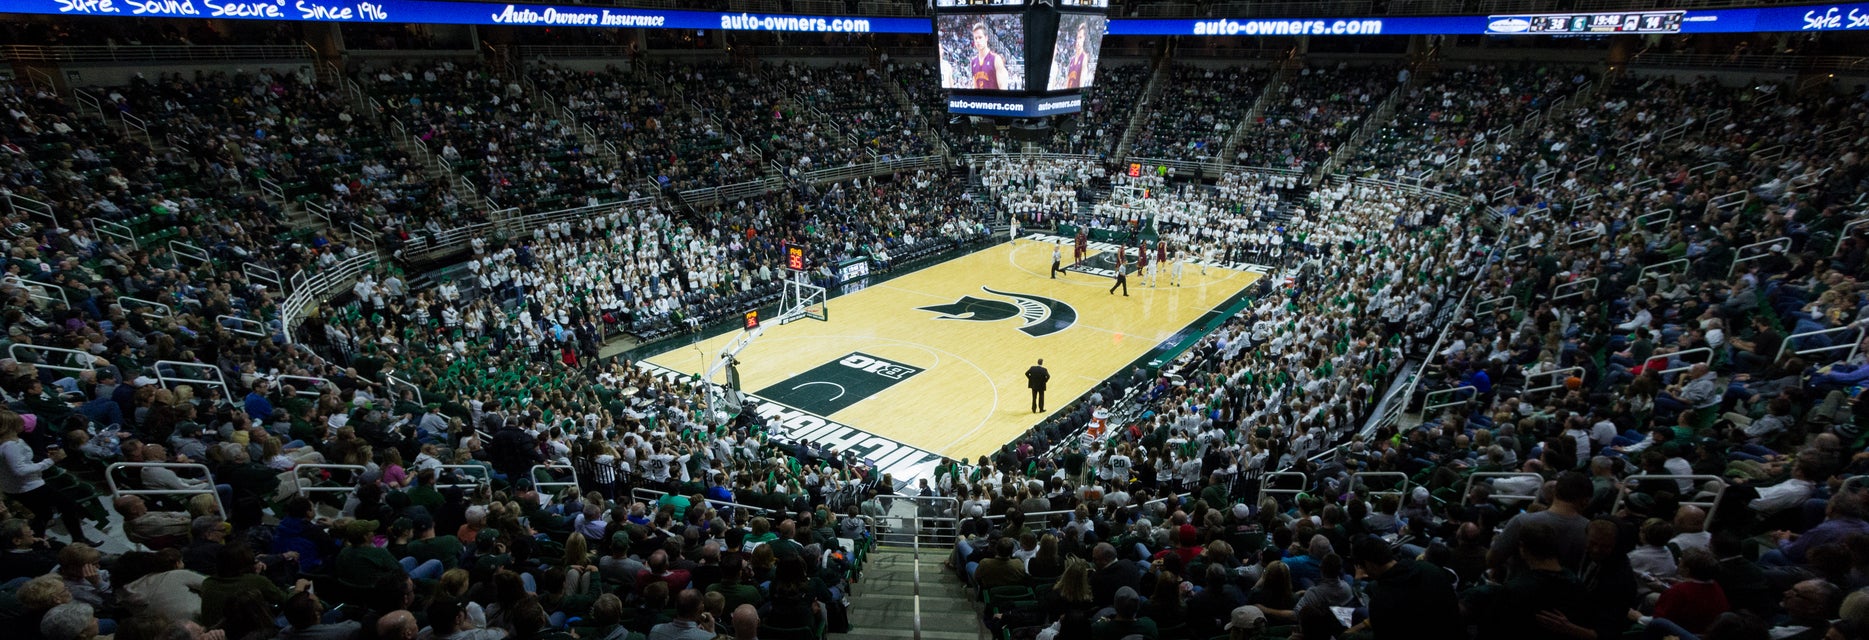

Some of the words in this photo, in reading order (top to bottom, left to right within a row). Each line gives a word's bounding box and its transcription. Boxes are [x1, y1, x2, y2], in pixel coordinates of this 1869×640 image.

[124, 0, 200, 15] Sound.
[296, 1, 353, 20] Since
[356, 1, 388, 21] 1916
[492, 5, 598, 26] Auto-Owners
[600, 9, 665, 27] Insurance
[1802, 7, 1842, 30] Safe.
[721, 12, 870, 33] auto-owners.com
[1193, 18, 1382, 36] auto-owners.com
[949, 99, 1024, 112] auto-owners.com
[790, 254, 803, 269] 35
[745, 396, 942, 494] MICHIGA
[1113, 459, 1125, 467] 20
